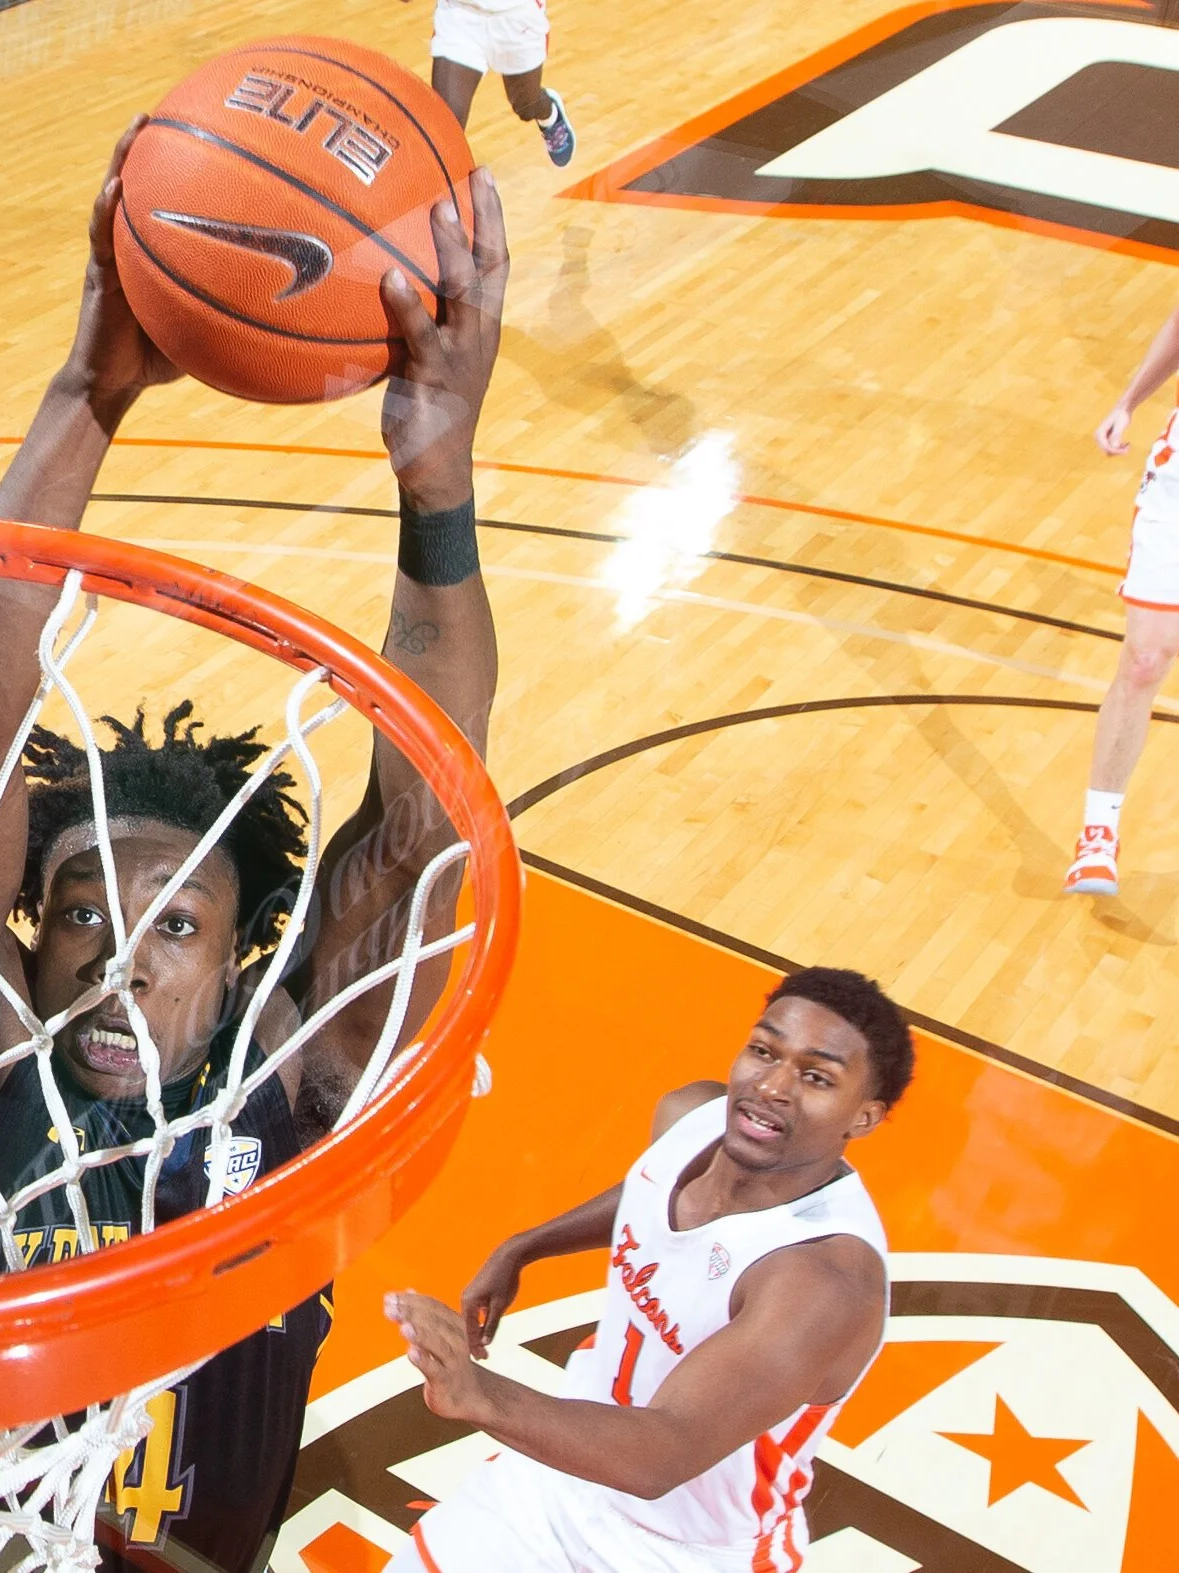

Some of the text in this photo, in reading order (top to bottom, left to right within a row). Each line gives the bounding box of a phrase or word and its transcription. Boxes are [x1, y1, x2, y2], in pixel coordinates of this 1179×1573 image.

[225, 74, 393, 187] ELITE
[613, 1224, 684, 1355] Falcons
[611, 1320, 646, 1406] 1
